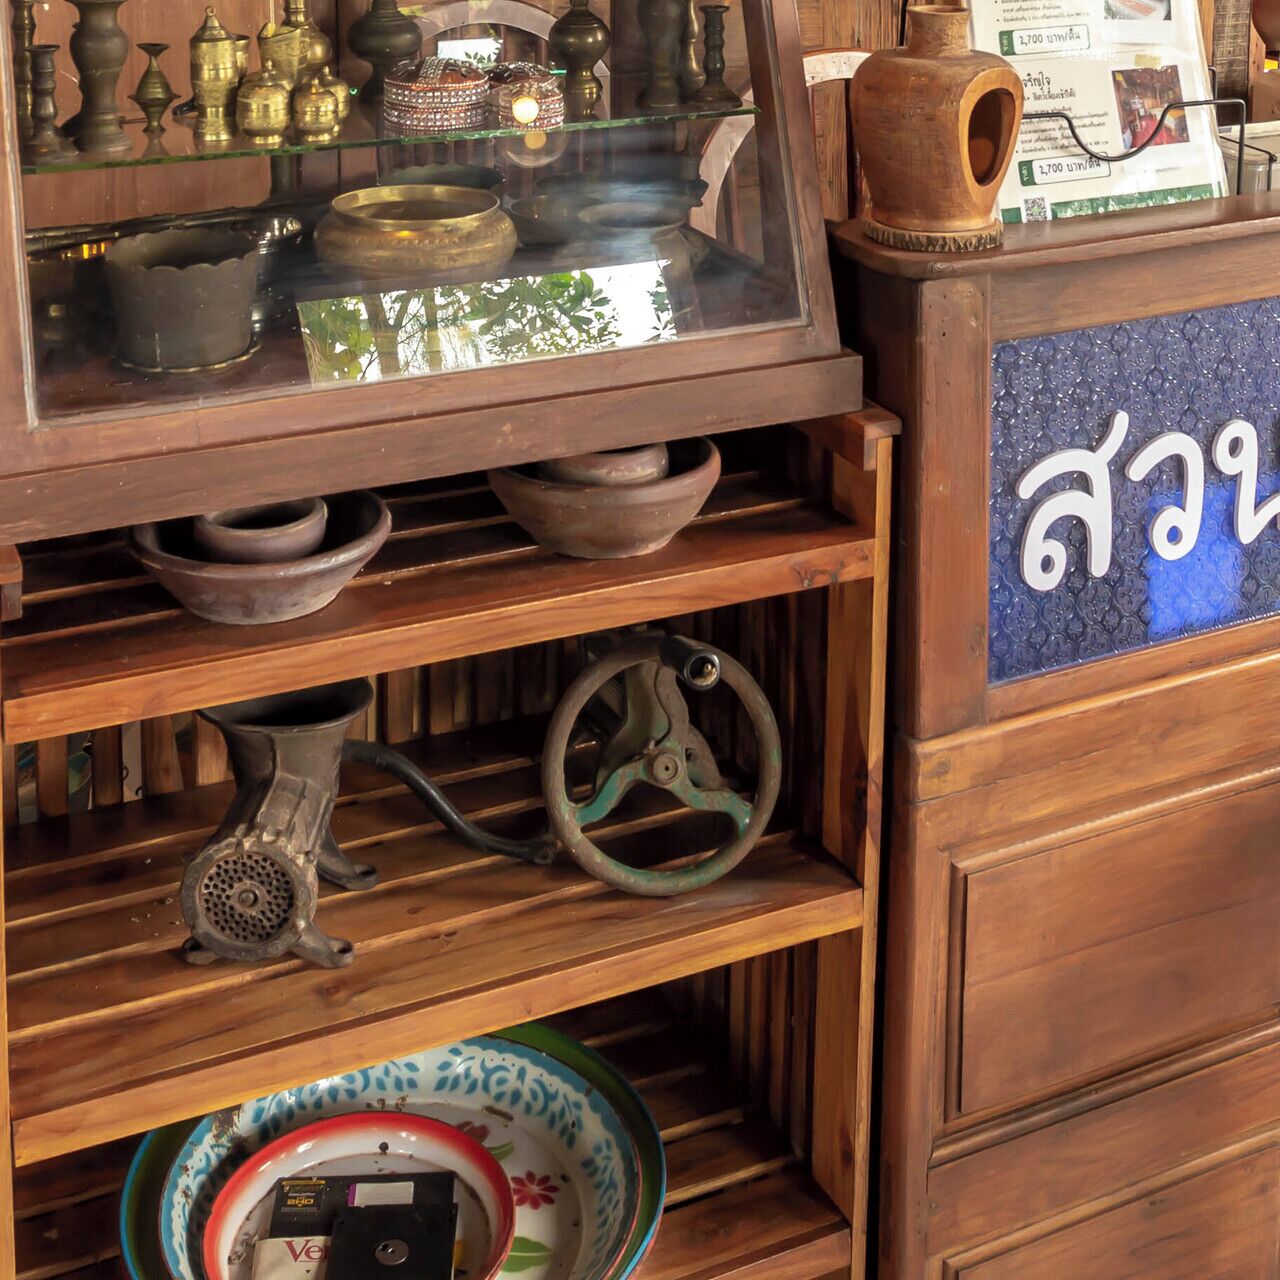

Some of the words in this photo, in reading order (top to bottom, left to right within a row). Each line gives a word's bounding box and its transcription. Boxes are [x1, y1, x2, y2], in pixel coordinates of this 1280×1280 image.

[1019, 34, 1043, 46] 2,700
[1046, 27, 1081, 44] บาท/คืน
[1039, 163, 1063, 175] 2,700
